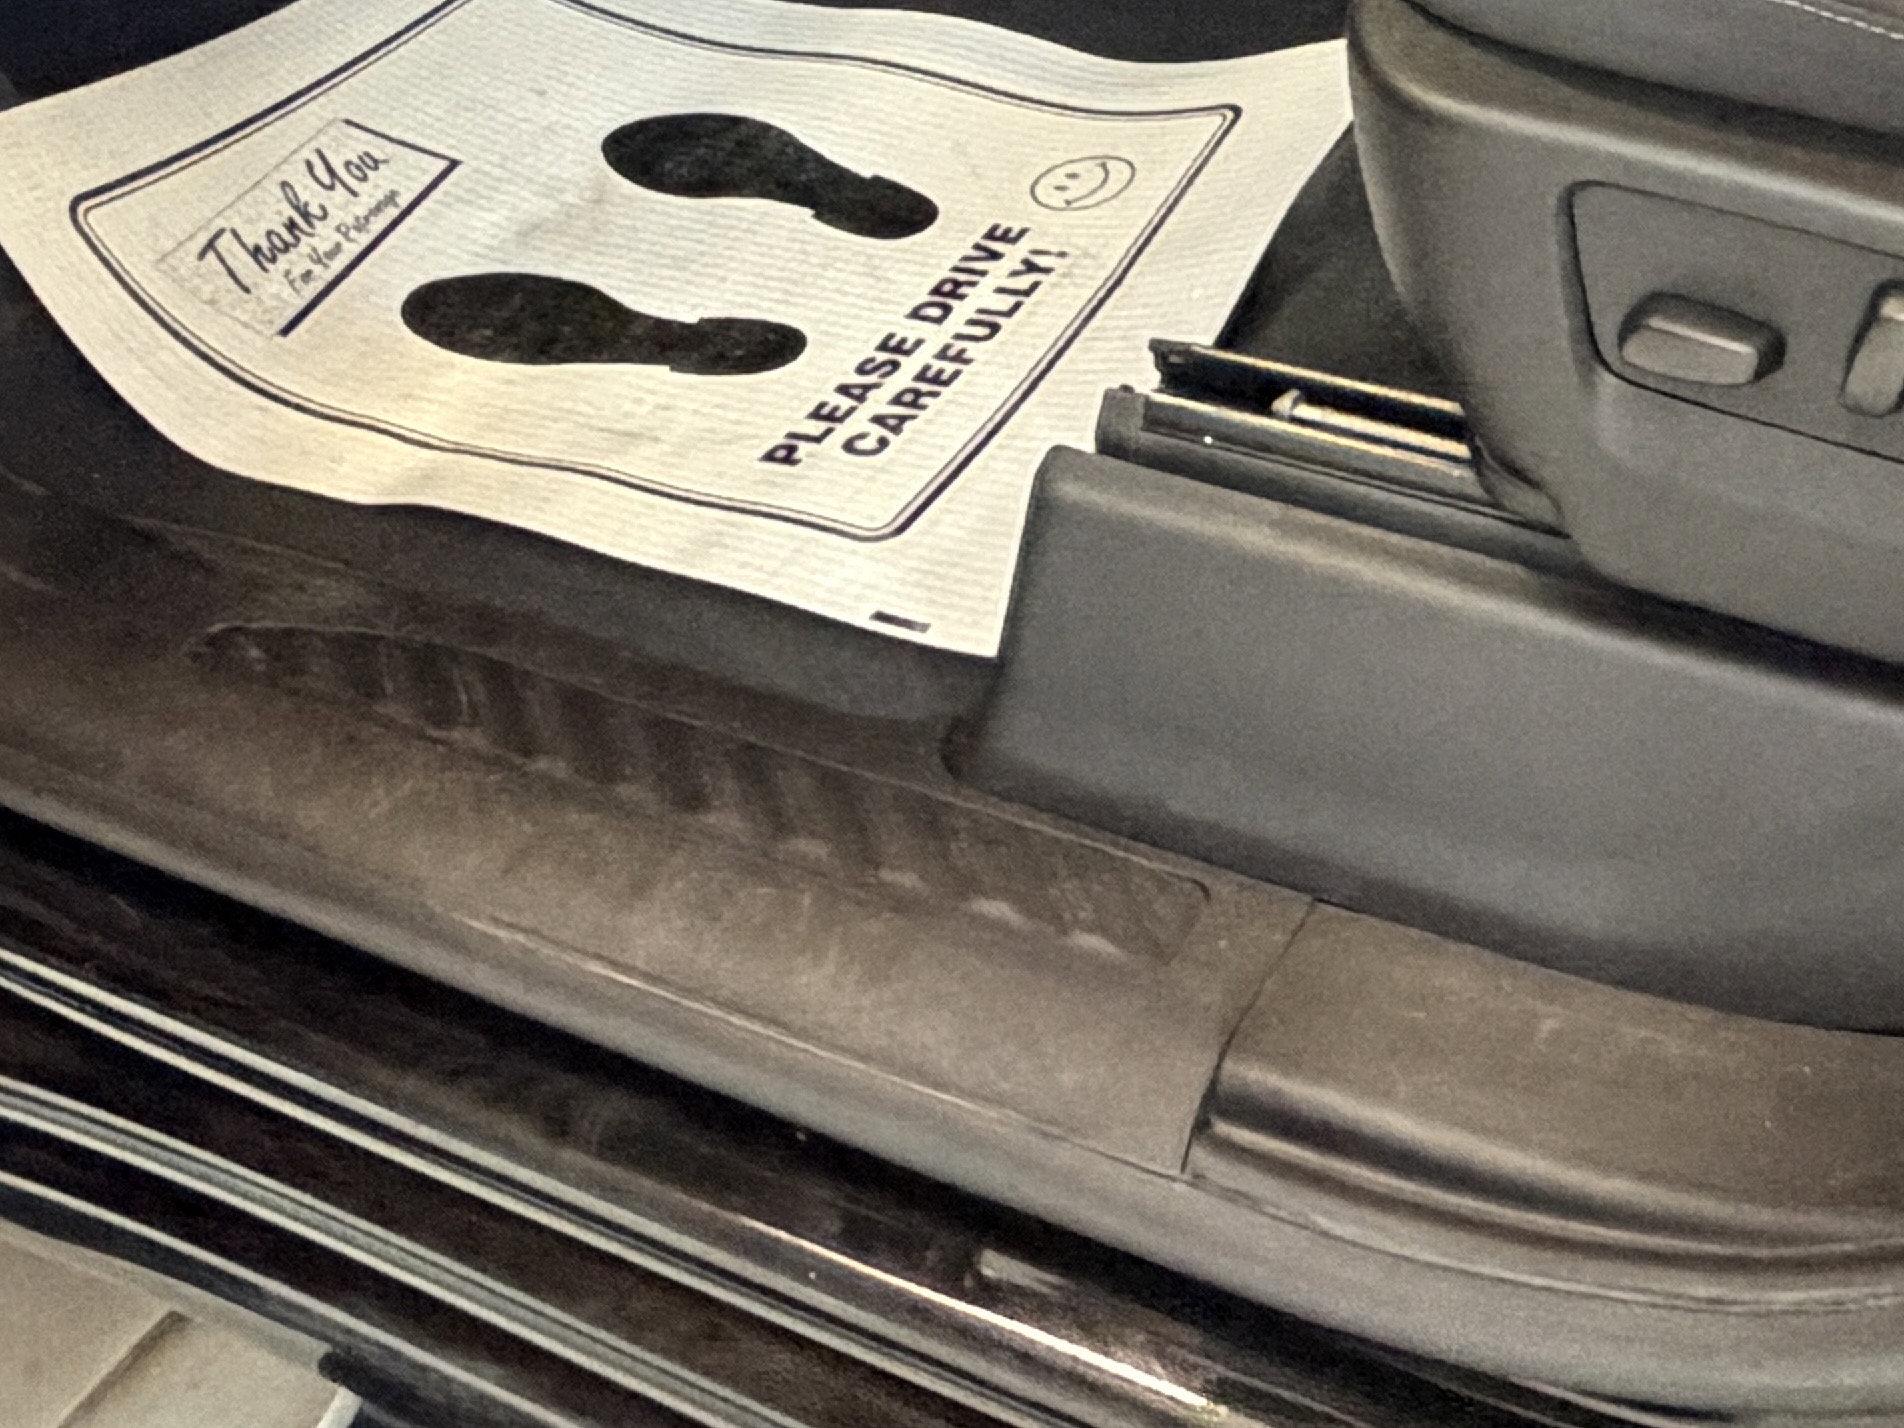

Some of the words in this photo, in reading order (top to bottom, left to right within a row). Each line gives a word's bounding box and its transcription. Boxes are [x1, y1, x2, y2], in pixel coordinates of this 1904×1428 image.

[197, 180, 329, 294] Thank
[304, 147, 390, 198] You
[758, 331, 926, 467] PLEASE
[903, 222, 1032, 326] DRIVE
[840, 247, 1071, 459] CAREFULLY!
